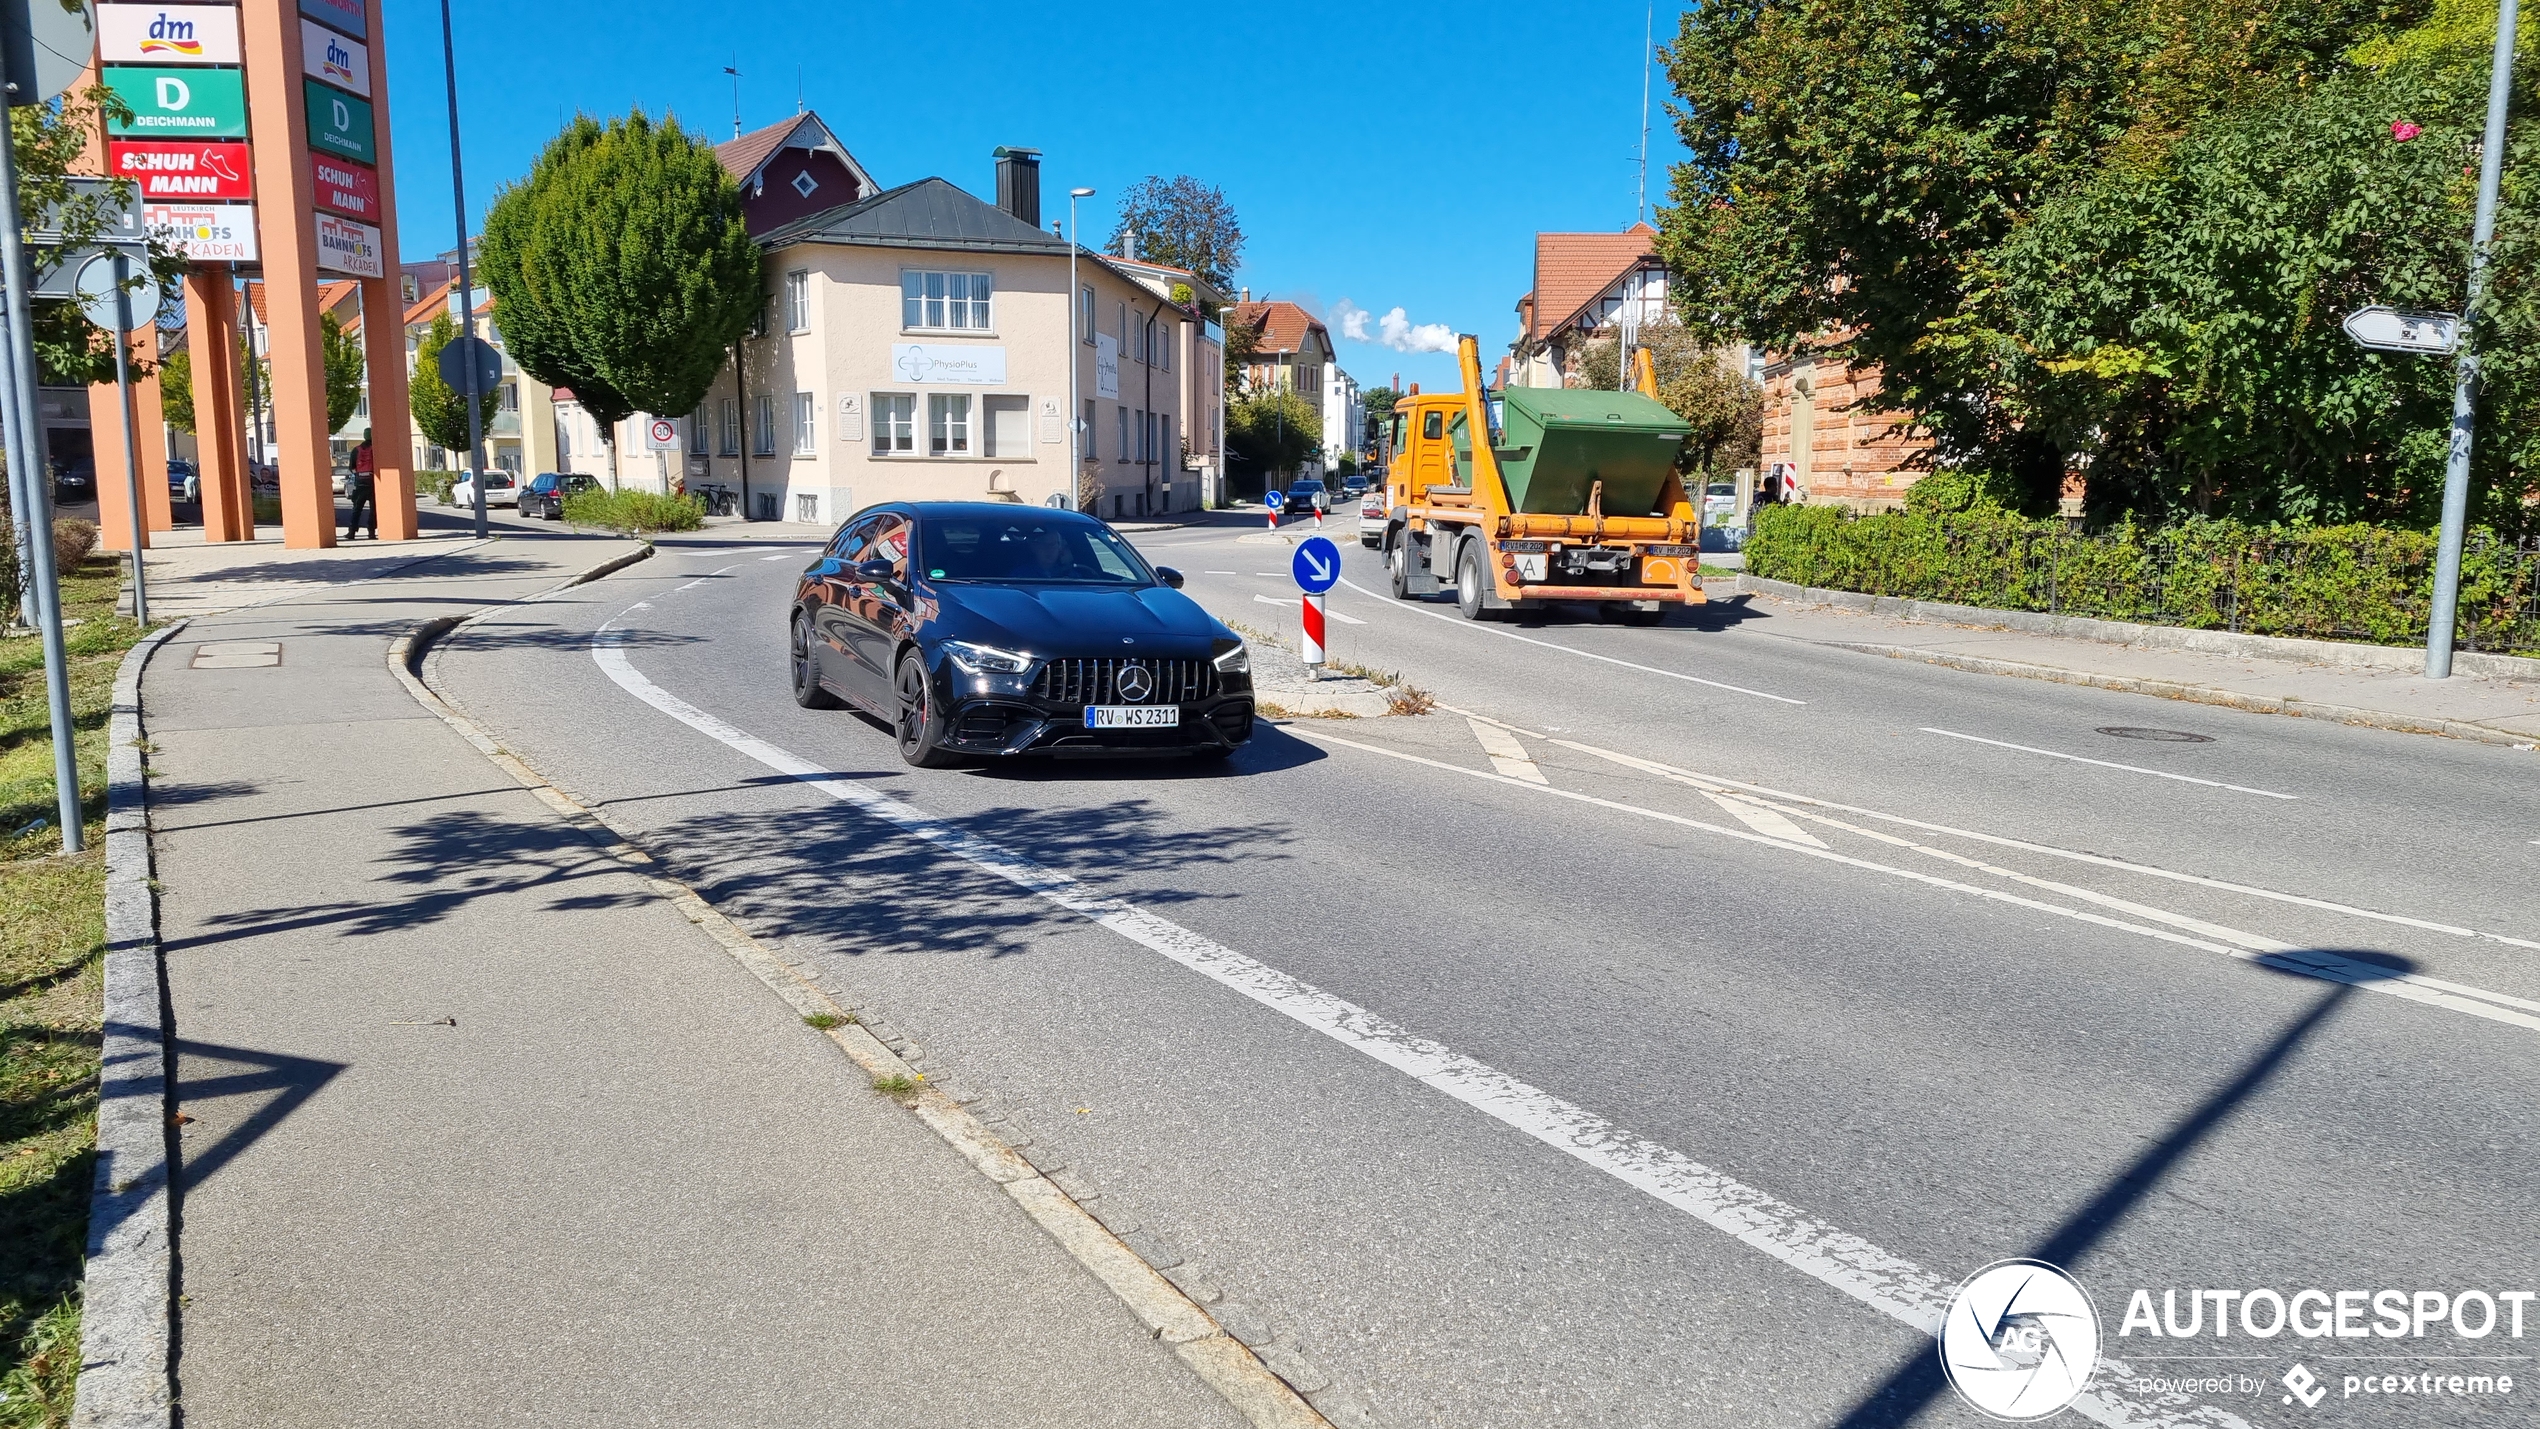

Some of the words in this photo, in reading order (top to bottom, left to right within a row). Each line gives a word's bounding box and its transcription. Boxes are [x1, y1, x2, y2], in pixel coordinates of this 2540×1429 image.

[149, 13, 193, 39] dm
[327, 38, 349, 68] dm
[156, 77, 190, 111] D
[137, 116, 216, 128] DEICHMANN
[333, 99, 349, 132] D
[324, 132, 362, 153] DEICHMANN
[121, 152, 195, 171] SCHUH
[149, 175, 218, 194] MANN
[318, 164, 353, 189] SCHUH
[332, 190, 365, 213] MANN
[322, 234, 373, 257] BAHNHOFS
[343, 253, 378, 275] ARKADEN
[934, 359, 978, 370] PhysioPlus
[656, 426, 669, 436] 30
[1505, 541, 1515, 549] RV
[1518, 542, 1529, 550] HR
[1530, 542, 1543, 550] 202
[1667, 546, 1677, 554] HR
[1677, 547, 1690, 555] 202
[1522, 557, 1536, 576] A
[1096, 709, 1114, 725] RV
[1125, 709, 1143, 725] WS
[1145, 709, 1177, 725] 2311
